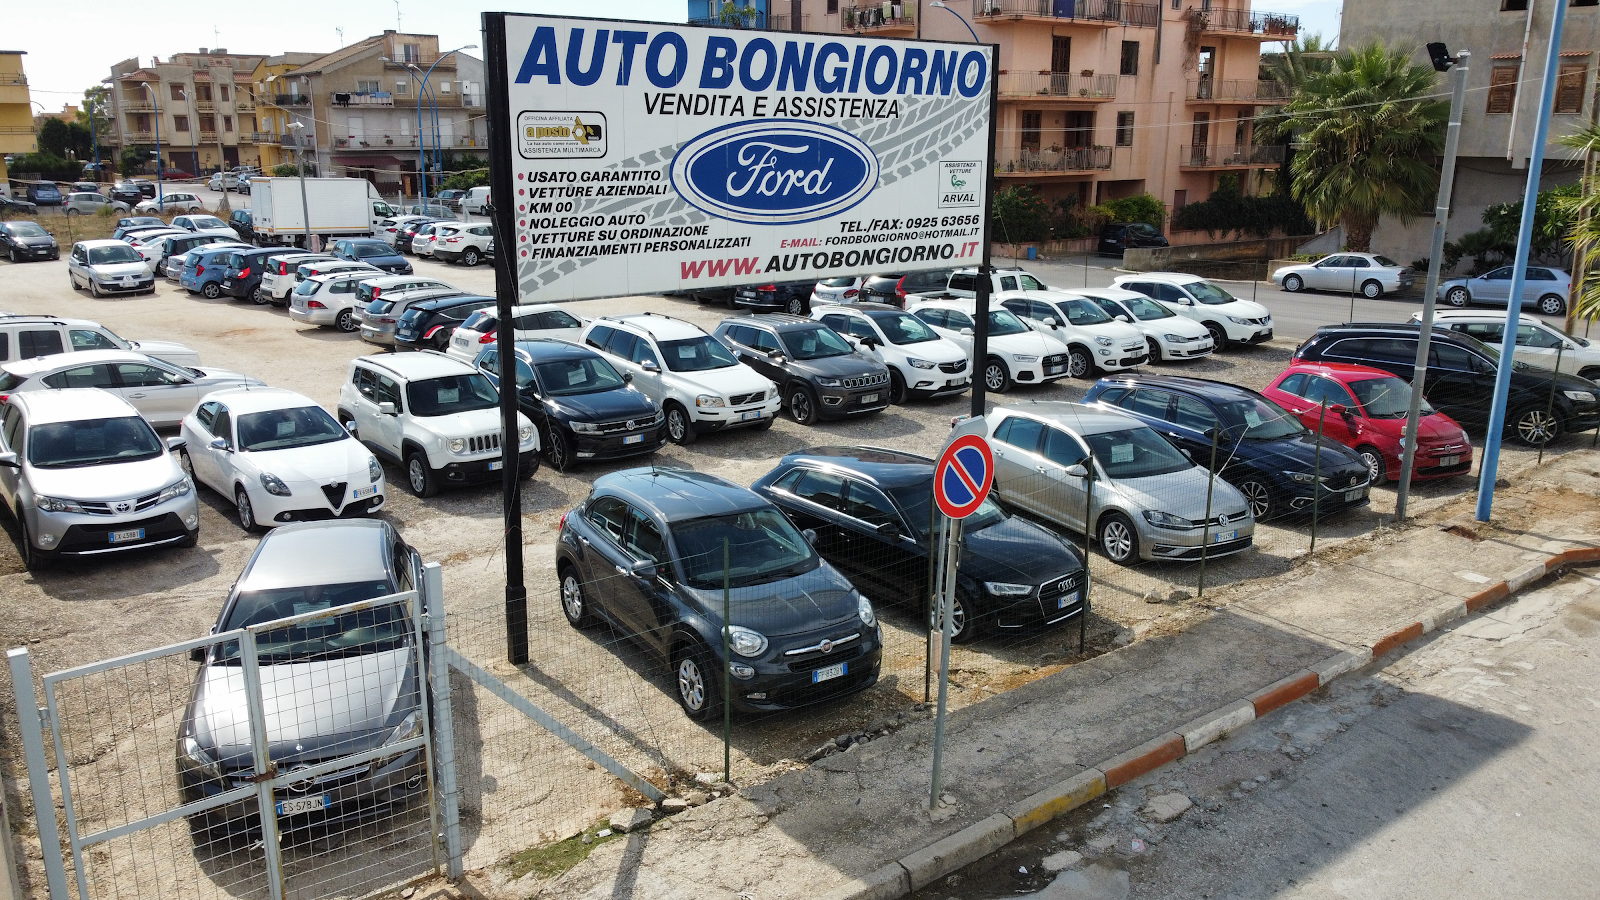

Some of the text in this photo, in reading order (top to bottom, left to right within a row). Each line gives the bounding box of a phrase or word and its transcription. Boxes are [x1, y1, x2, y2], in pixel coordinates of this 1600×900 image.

[515, 26, 987, 99] AUTO BONGIORNO
[644, 92, 900, 120] VENDITA E ASSISTENZA
[526, 126, 570, 139] a posto
[527, 170, 661, 183] USATO GARANTITO
[725, 140, 835, 199] Ford
[529, 184, 668, 199] VETTURE AZIENDALI
[942, 193, 975, 203] ARVAL
[529, 201, 573, 214] KM 00
[529, 214, 646, 229] NOLEGGIO AUTO
[840, 214, 980, 234] TEL./FAX: 0925 63656
[531, 225, 710, 244] VETTURE SU ORDINAZIONE
[780, 227, 980, 249] E-MAIL: FORDBONGIORNO@HOTMAIL.IT
[531, 236, 752, 260] FINANZIAMENTI PERSONALIZZATI
